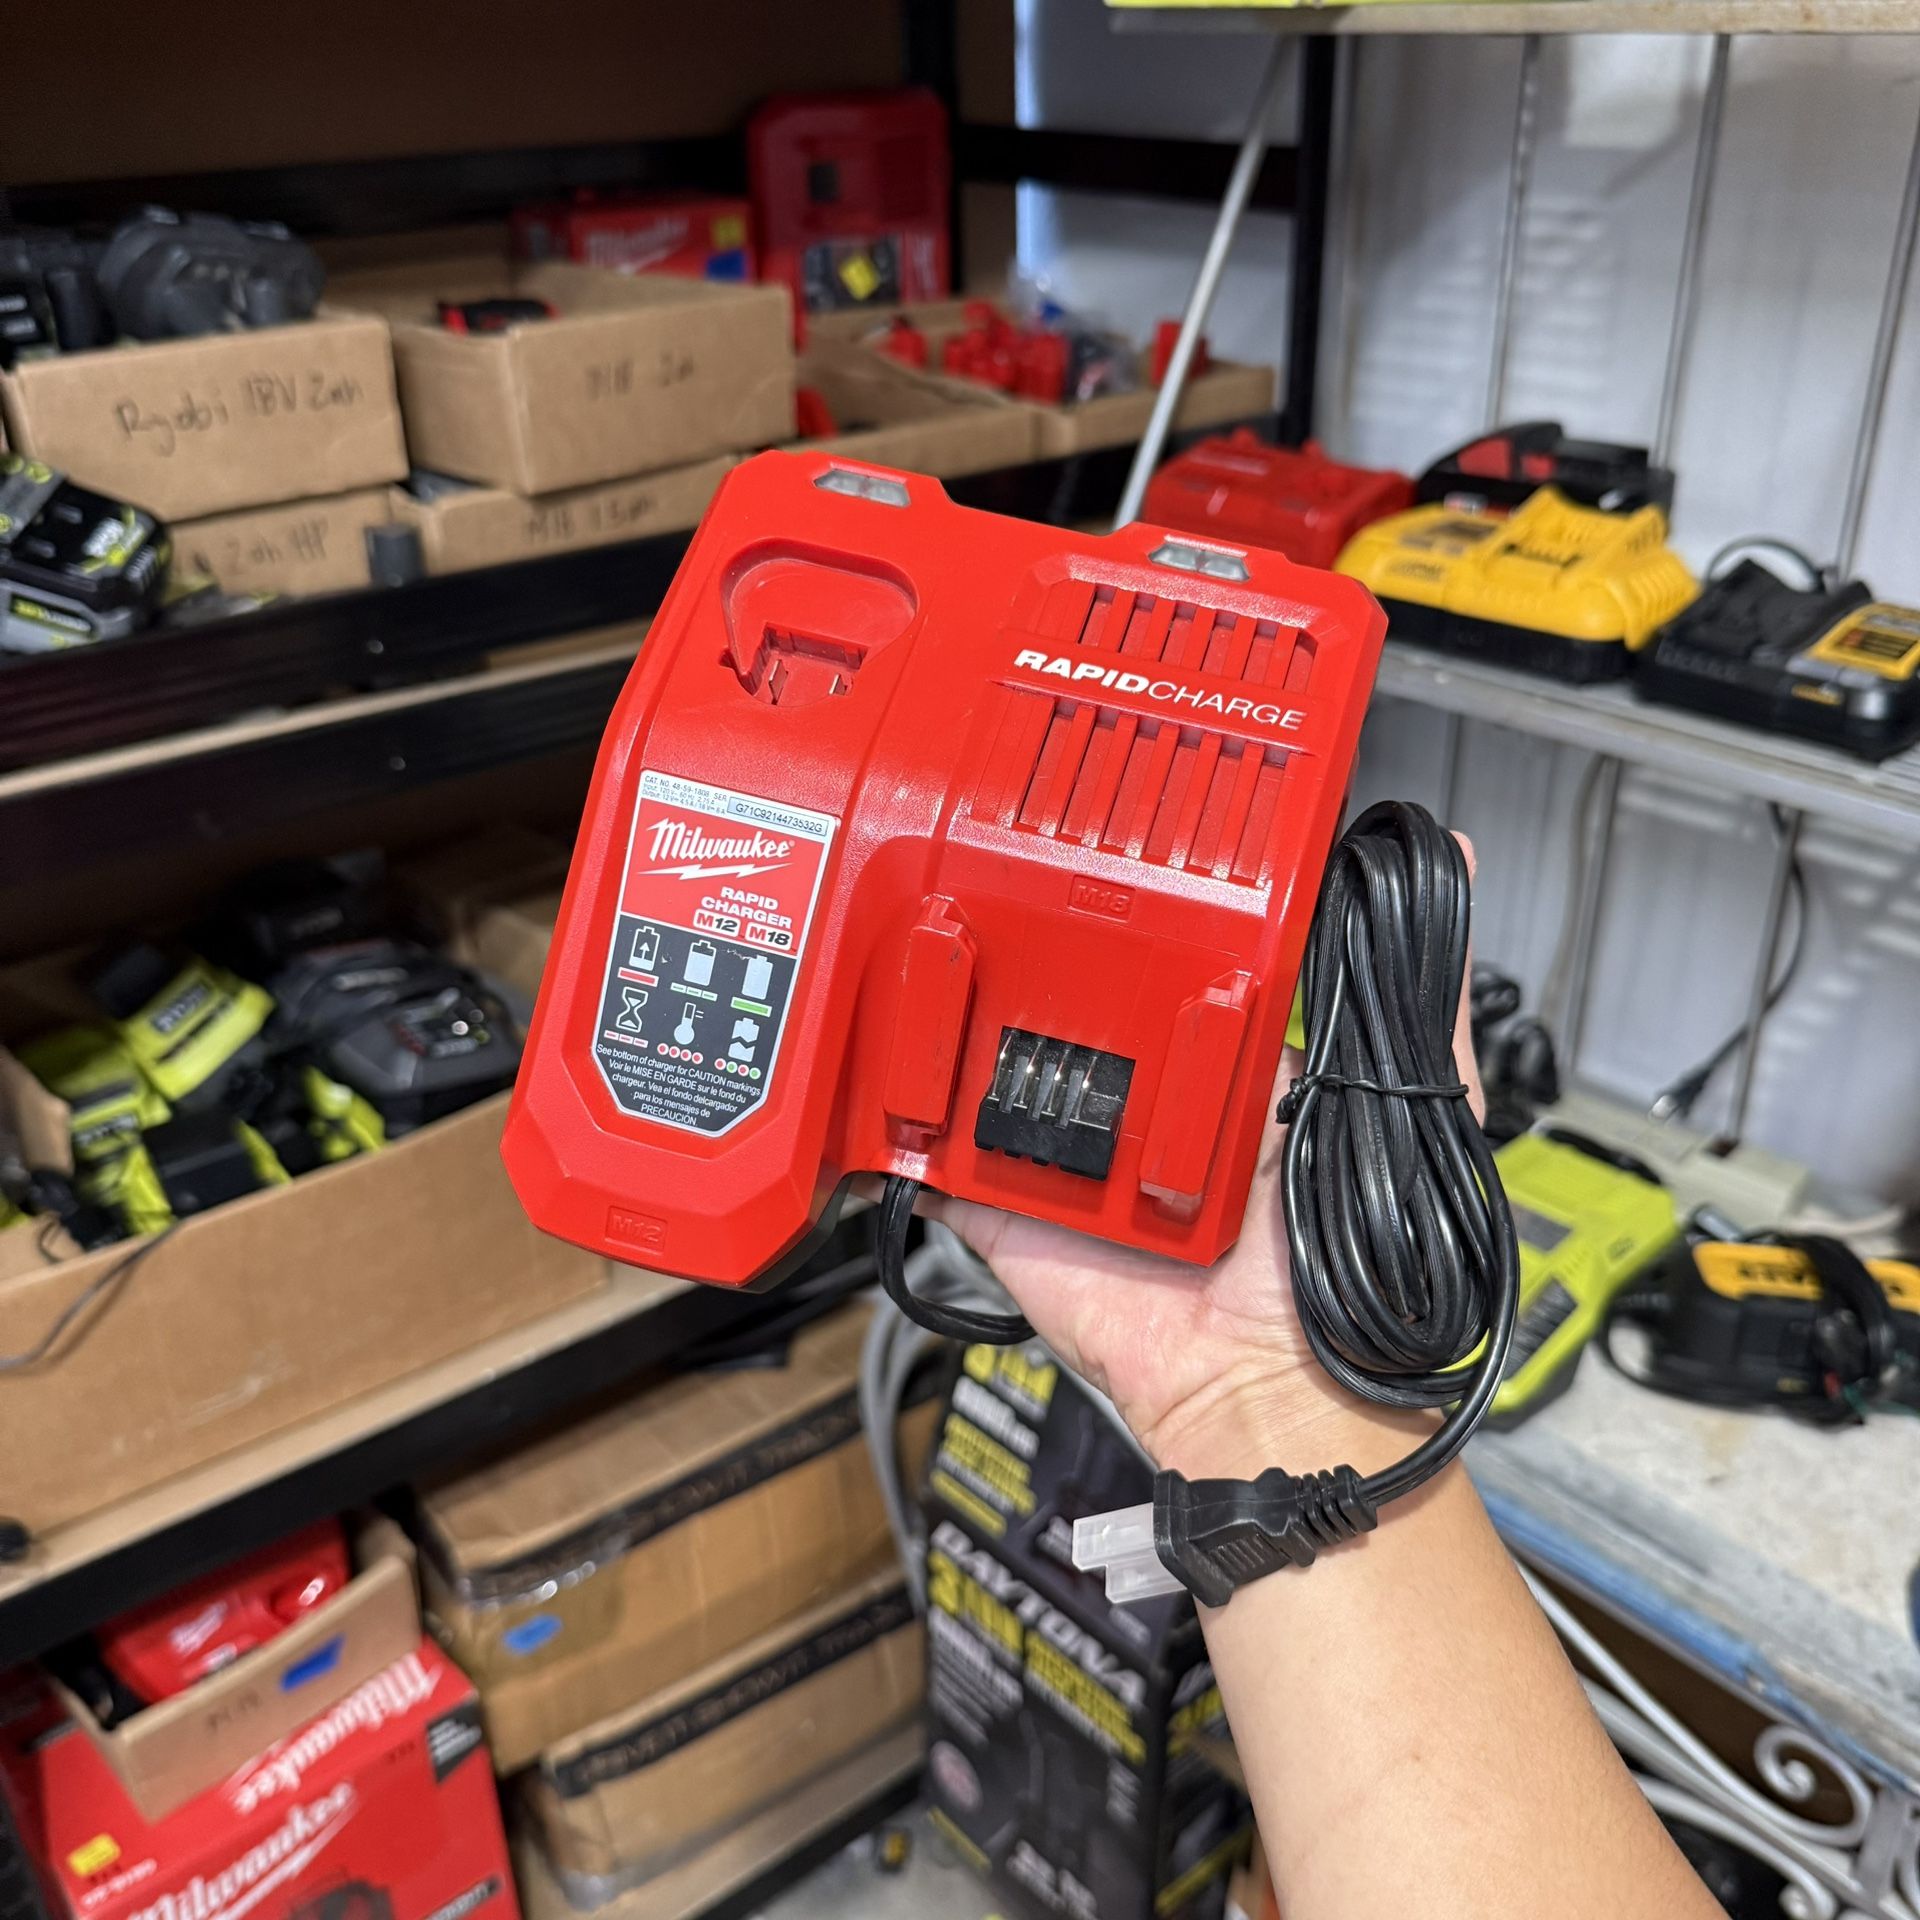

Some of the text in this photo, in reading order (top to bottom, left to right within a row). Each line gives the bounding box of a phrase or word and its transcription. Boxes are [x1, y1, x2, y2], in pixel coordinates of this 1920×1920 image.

[116, 393, 230, 457] Ryobi
[1014, 649, 1307, 731] RAPIDCHARGE
[646, 817, 792, 862] Milwaukee
[701, 896, 792, 929] CHARGER
[720, 886, 779, 911] RAPID
[1072, 885, 1130, 914] M18
[695, 912, 790, 946] M12 M18
[596, 1043, 761, 1096] See bottom of charger for CAUTION markings
[609, 1058, 746, 1104] Voir le MISE EN GARDE sur le fond du
[612, 1073, 646, 1088] chargeur.
[648, 1081, 662, 1093] Vea
[663, 1085, 671, 1095] el
[671, 1087, 693, 1101] fondo
[633, 1091, 711, 1118] para los mensajes de
[613, 1214, 661, 1242] M12
[930, 1519, 1147, 1713] DAYTONA
